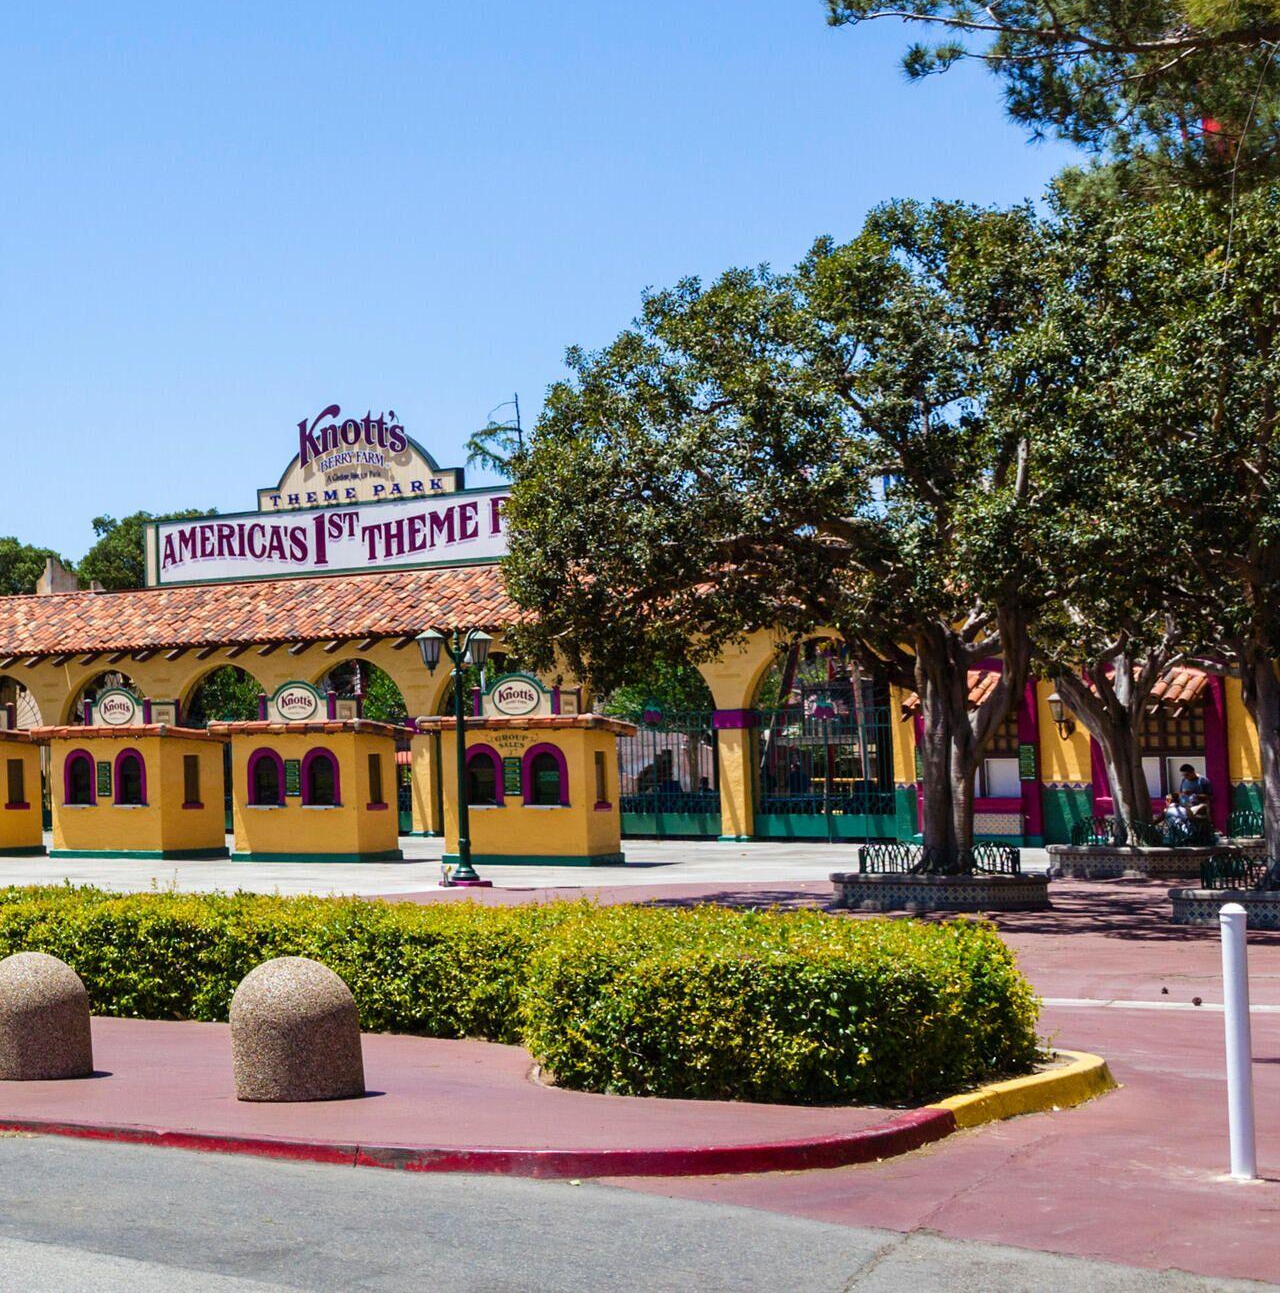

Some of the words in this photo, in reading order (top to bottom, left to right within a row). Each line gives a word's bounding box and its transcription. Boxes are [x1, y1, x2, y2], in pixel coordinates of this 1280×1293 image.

[297, 404, 408, 469] Knott's
[320, 451, 354, 473] BERRY
[356, 451, 385, 468] FARM
[269, 487, 356, 507] THEME
[373, 478, 443, 496] PARK
[161, 523, 309, 570] AMERICA'S
[313, 511, 360, 565] 1ST
[362, 501, 479, 560] THEME
[281, 693, 313, 709] Knott's
[498, 687, 534, 703] Knott's
[103, 699, 131, 715] Knott's
[495, 734, 528, 742] GROUP
